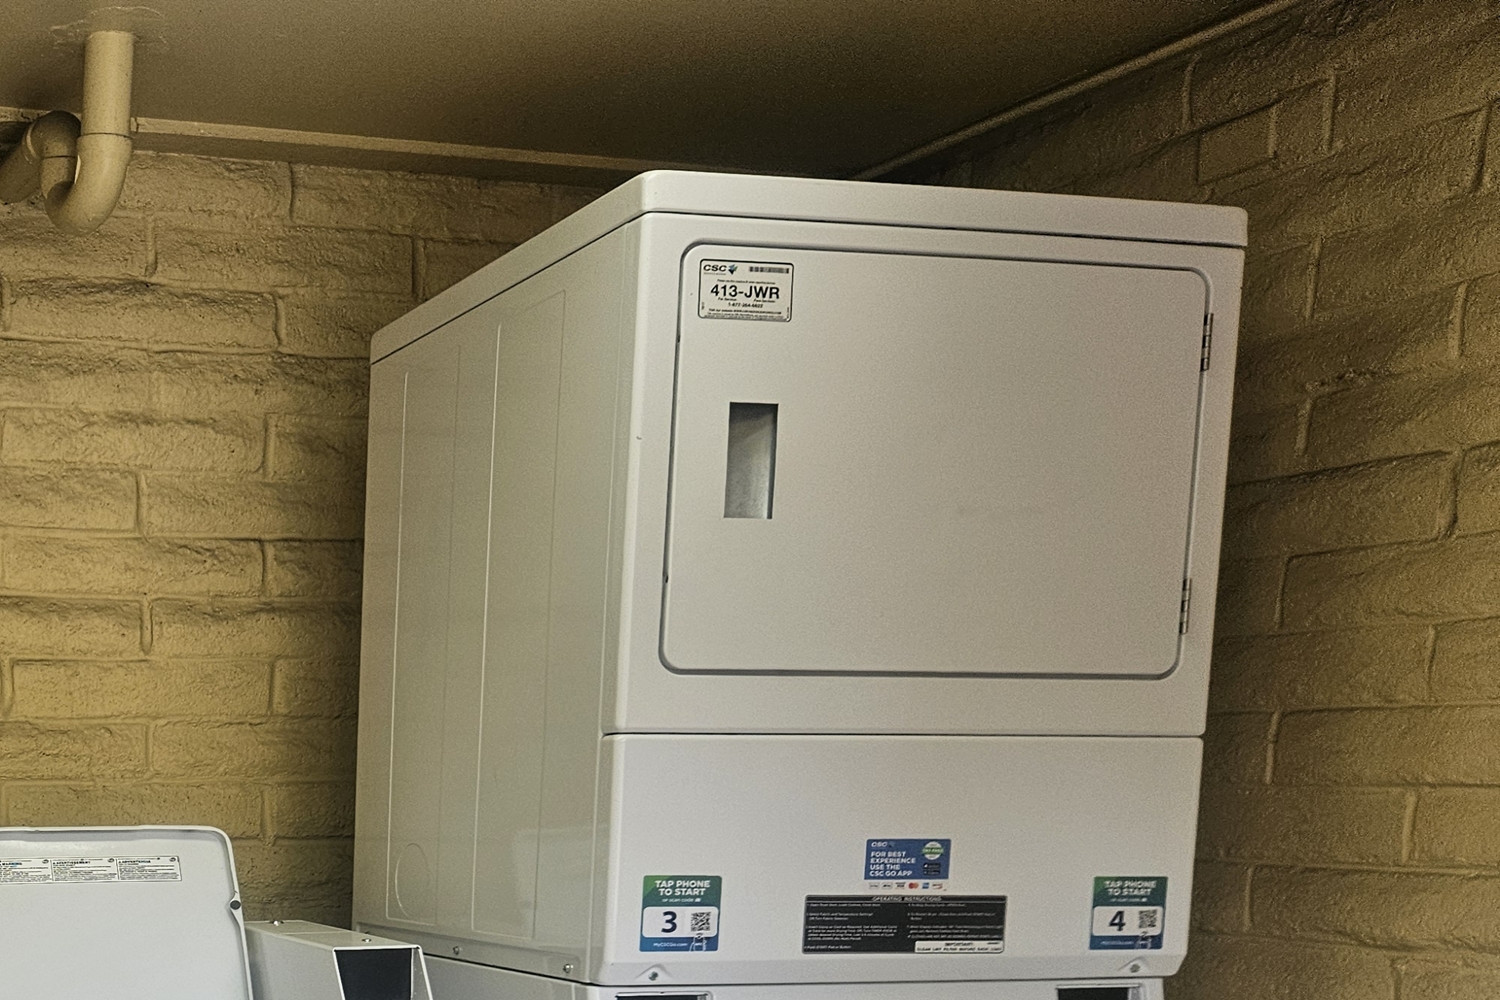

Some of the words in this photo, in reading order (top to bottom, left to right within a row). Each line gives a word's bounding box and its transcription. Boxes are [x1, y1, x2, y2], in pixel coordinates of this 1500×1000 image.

[703, 264, 727, 272] CSC
[710, 284, 780, 299] 413-JWR
[654, 880, 674, 888] TAP
[676, 880, 711, 888] PHONE
[658, 888, 673, 896] TO
[674, 888, 706, 896] START
[661, 910, 678, 933] 3
[1109, 910, 1126, 932] 4
